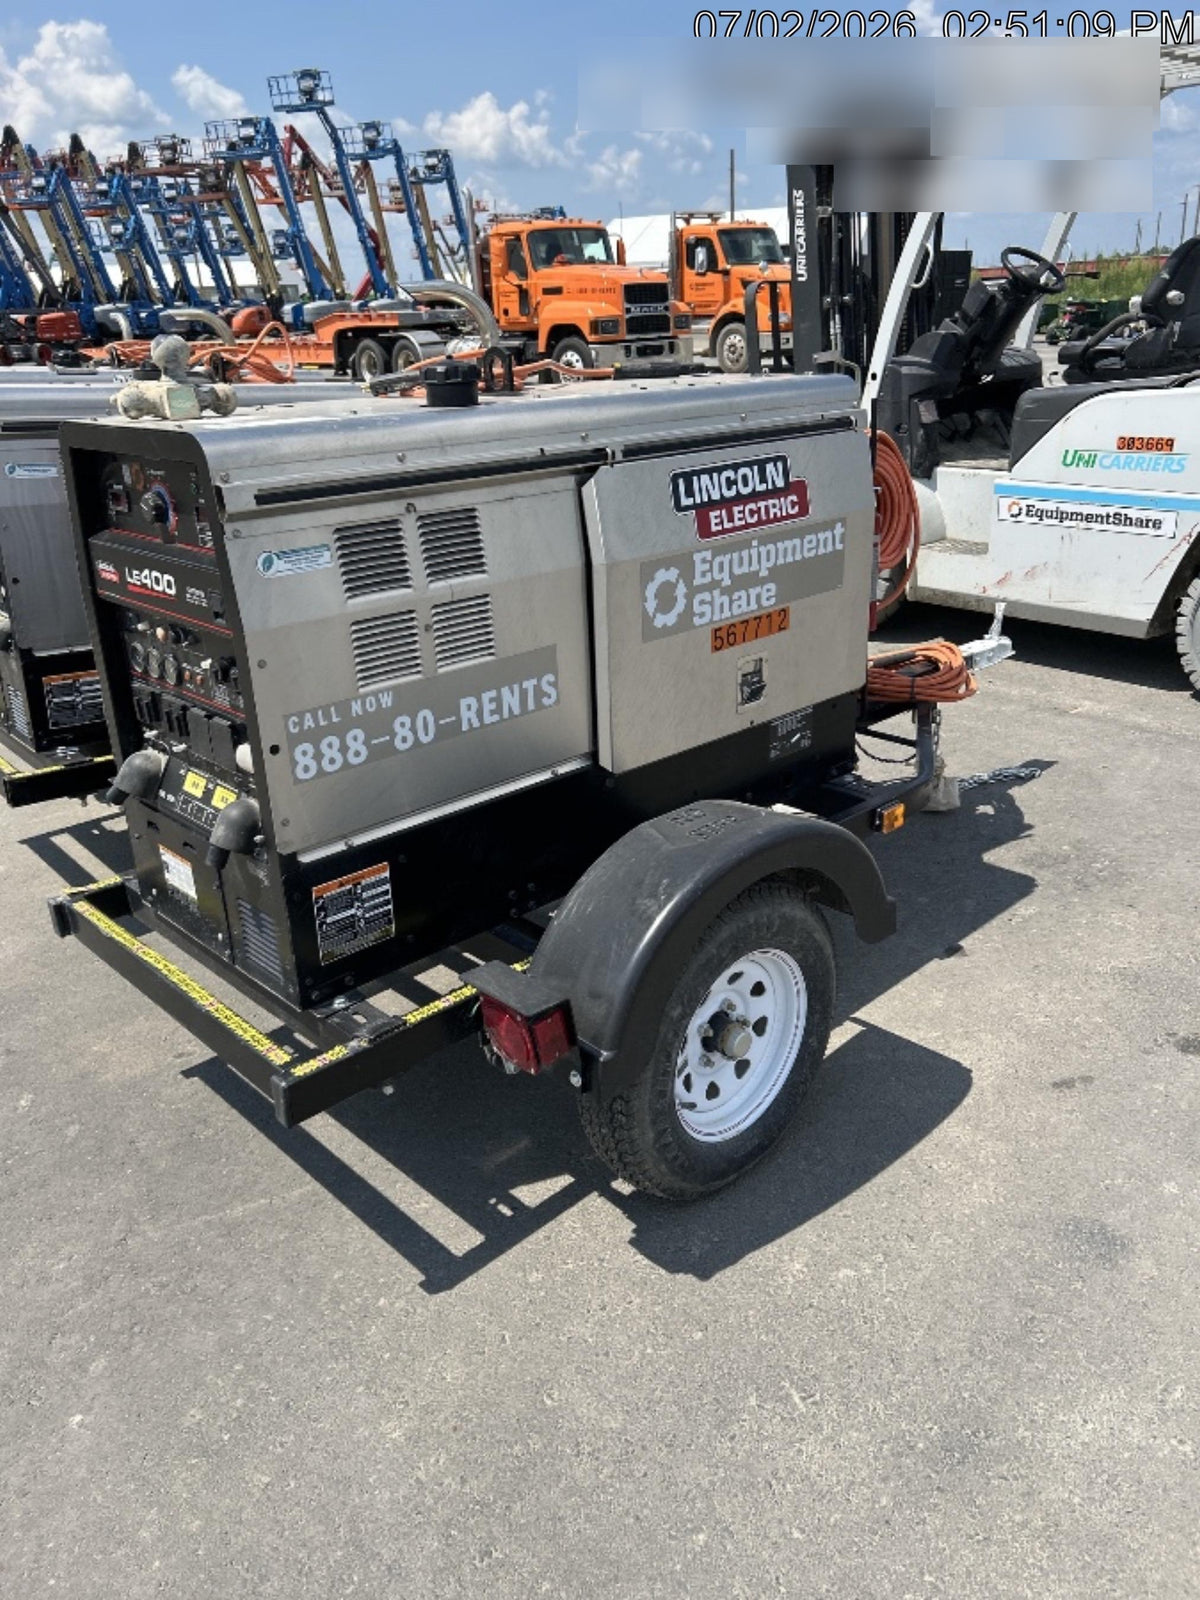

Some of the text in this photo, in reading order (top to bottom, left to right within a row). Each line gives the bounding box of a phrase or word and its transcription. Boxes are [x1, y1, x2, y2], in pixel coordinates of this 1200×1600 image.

[678, 460, 785, 507] LINCOLN
[709, 494, 800, 532] ELECTRIC
[1025, 504, 1163, 530] EquipmentShare
[693, 522, 845, 587] Equipment
[125, 567, 177, 596] LE400
[693, 582, 777, 627] Share
[713, 607, 788, 651] 567712
[288, 691, 394, 734] CALL NOW
